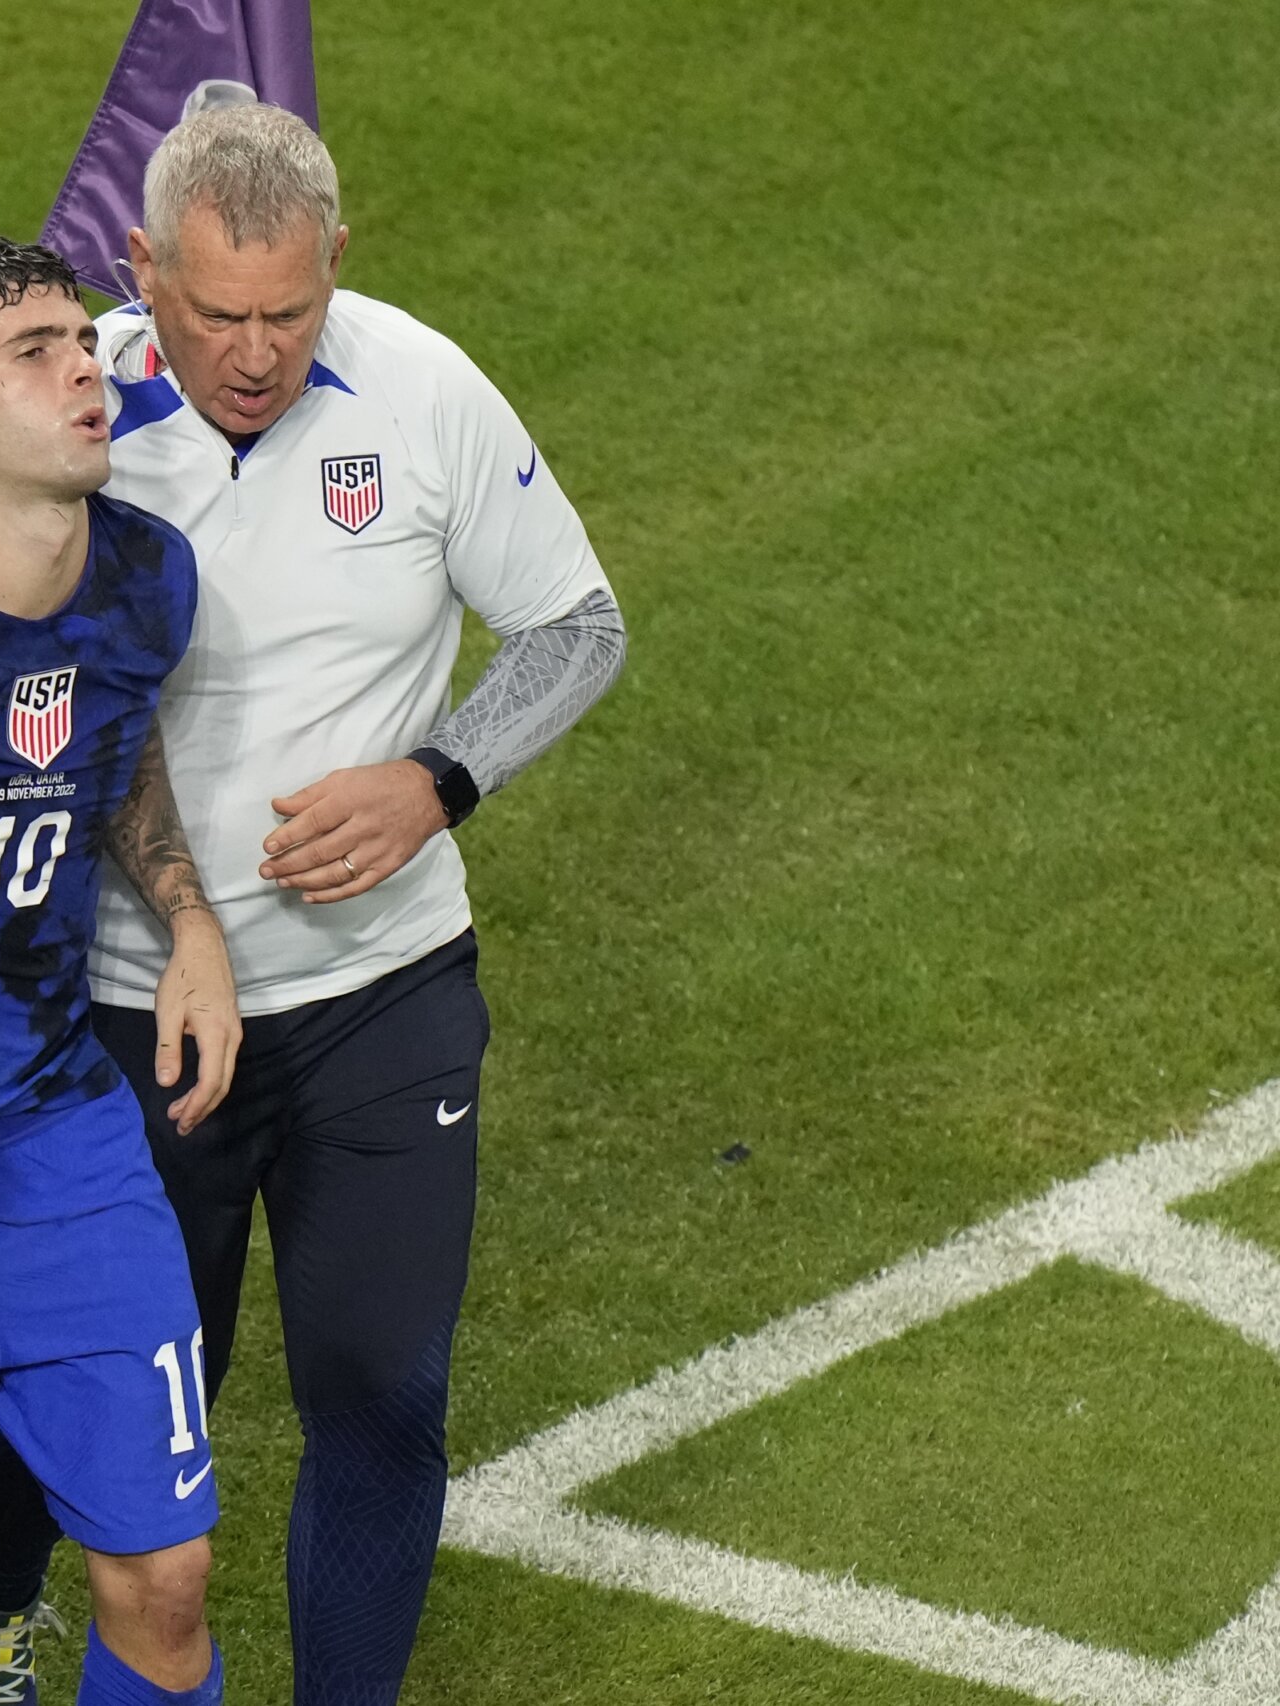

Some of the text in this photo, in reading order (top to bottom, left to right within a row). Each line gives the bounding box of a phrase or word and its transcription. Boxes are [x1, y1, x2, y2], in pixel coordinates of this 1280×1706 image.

[327, 461, 375, 489] USA
[16, 672, 72, 711] USA
[6, 786, 54, 800] NOVEMBER
[53, 783, 76, 797] 2022
